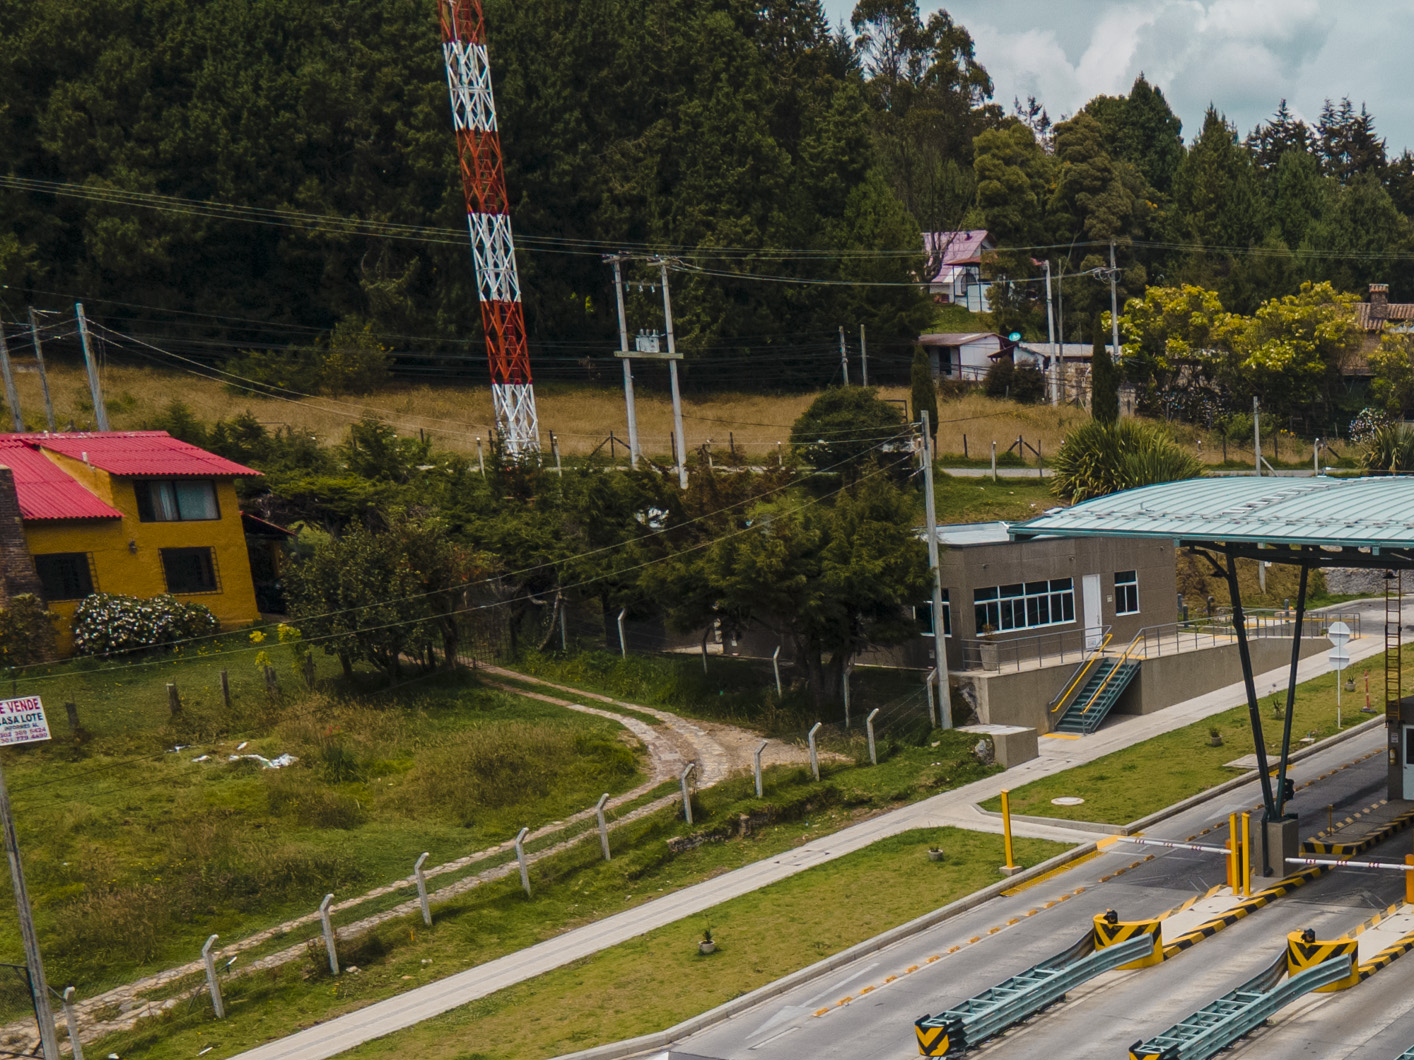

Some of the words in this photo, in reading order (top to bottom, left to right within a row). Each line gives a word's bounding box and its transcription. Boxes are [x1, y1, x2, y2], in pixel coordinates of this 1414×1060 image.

[6, 698, 40, 712] VENDE
[0, 716, 19, 725] ASA
[21, 713, 43, 722] LOTE
